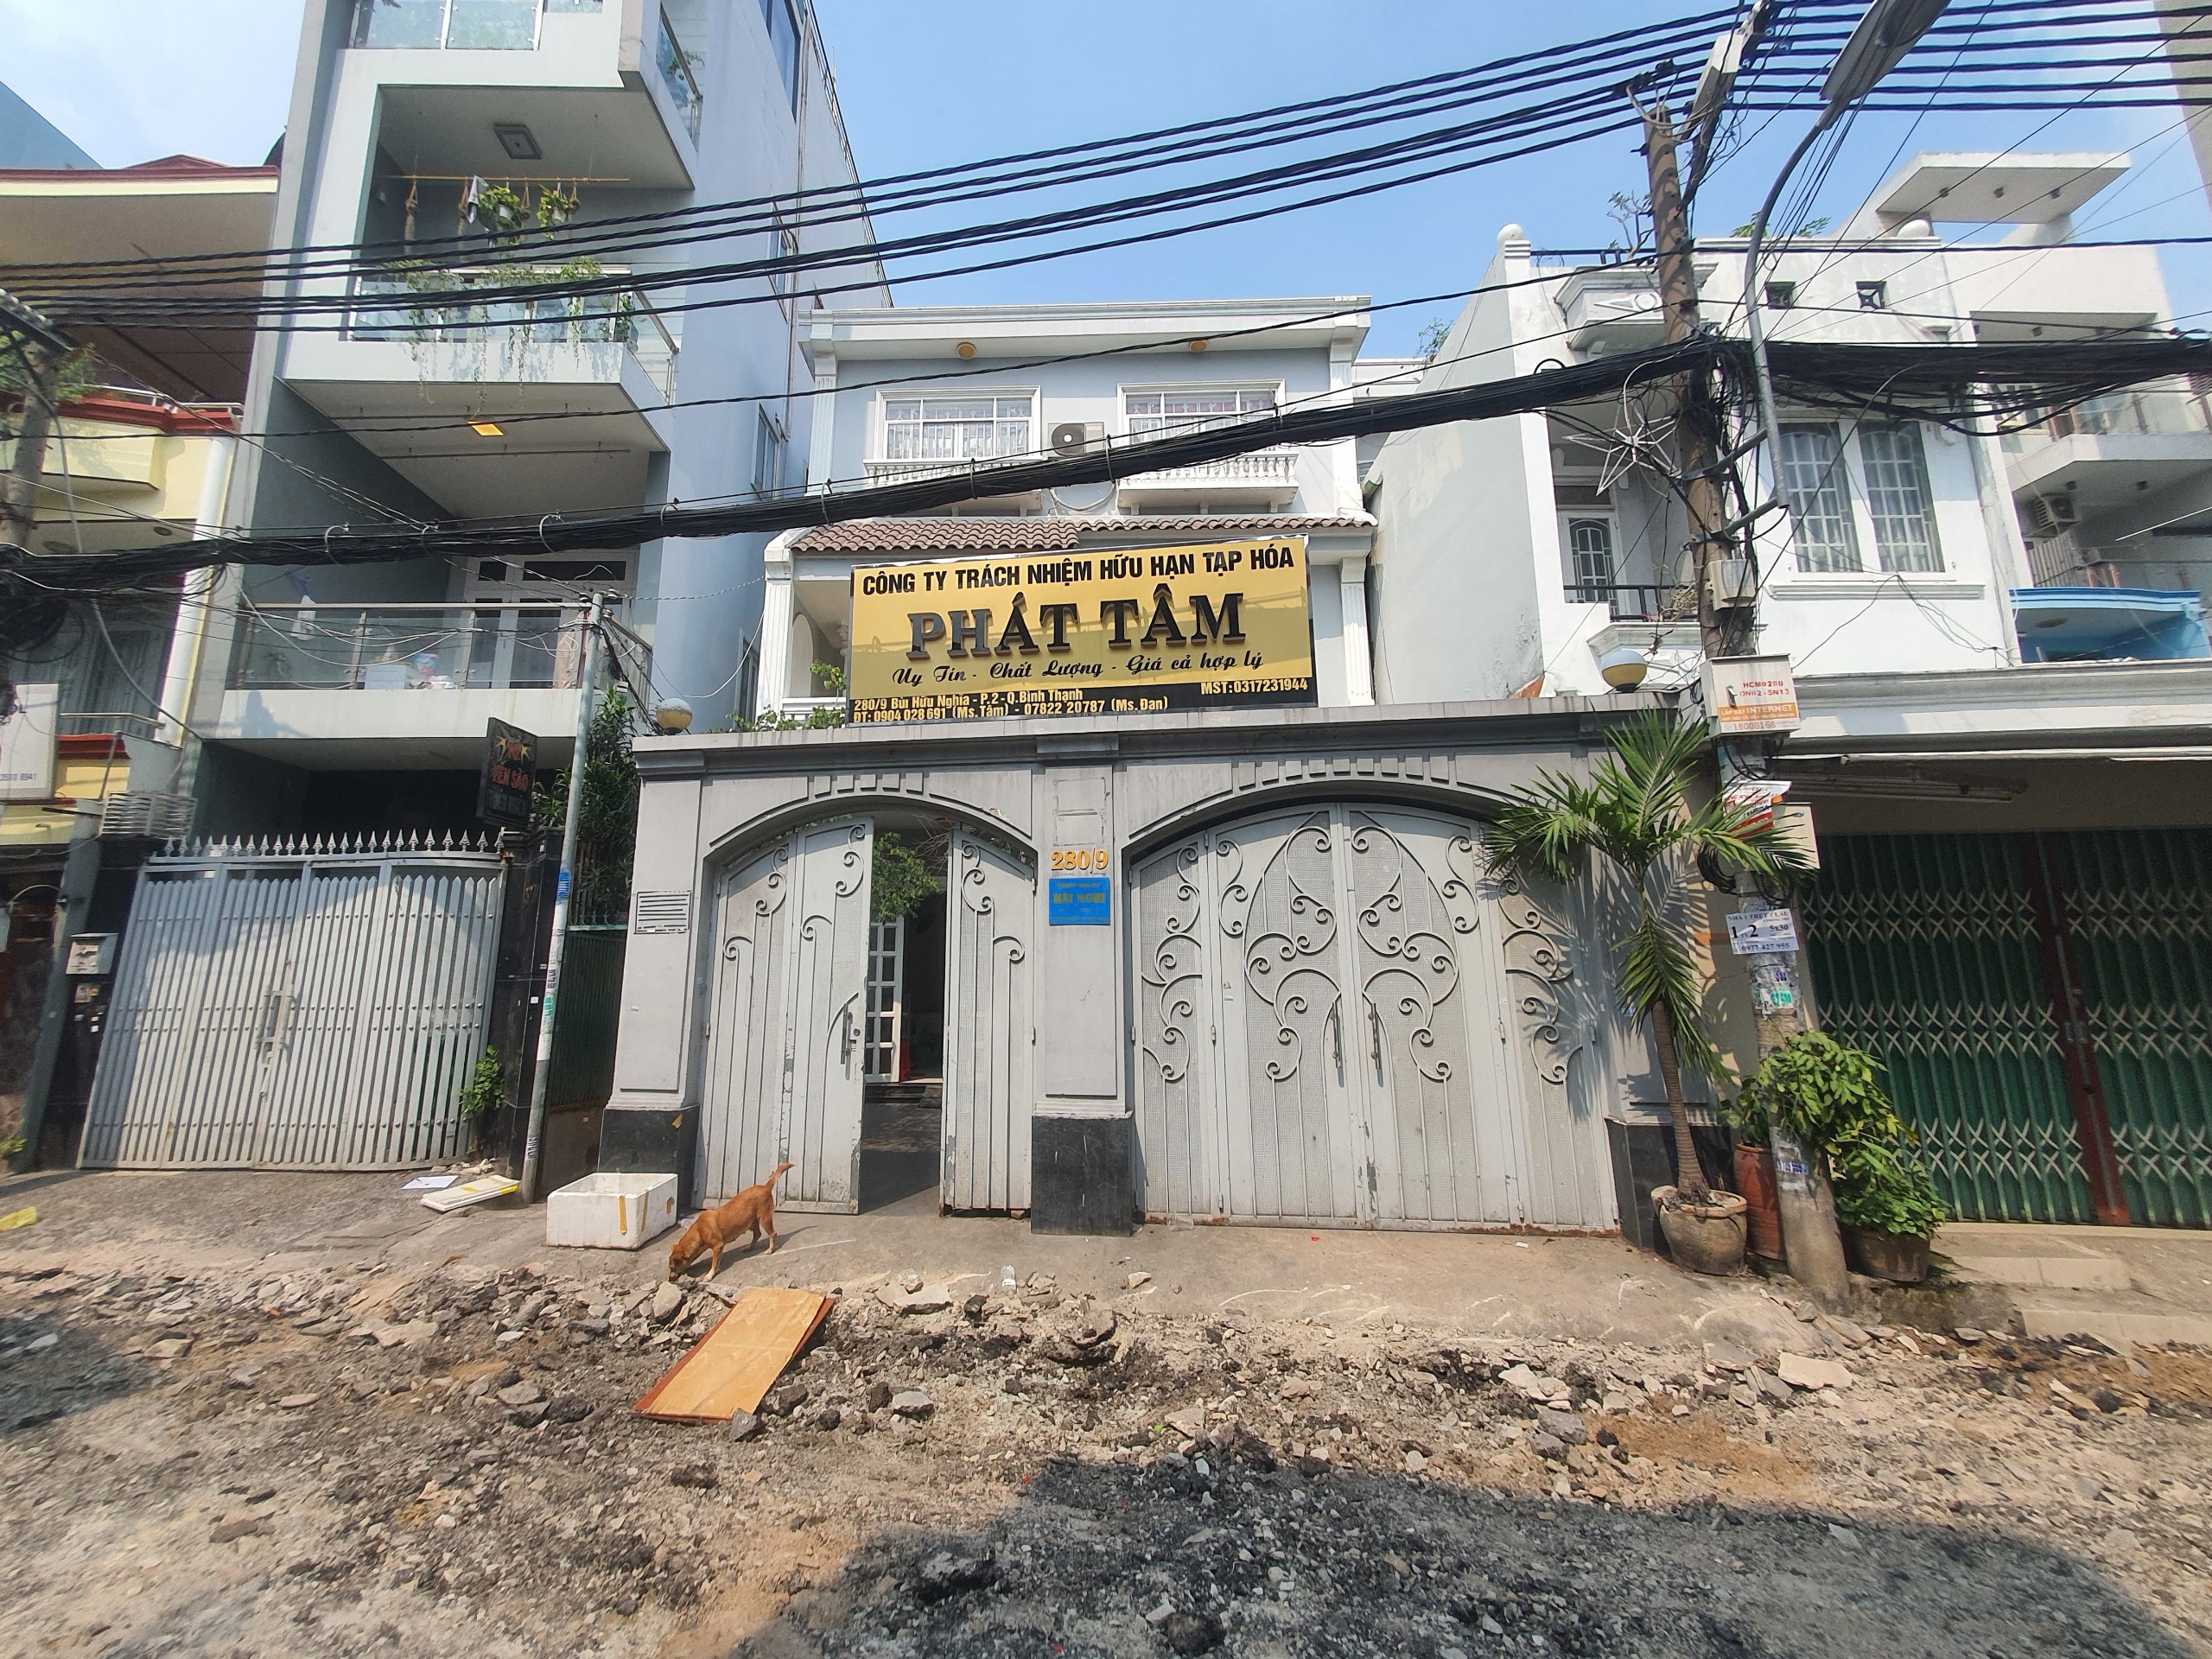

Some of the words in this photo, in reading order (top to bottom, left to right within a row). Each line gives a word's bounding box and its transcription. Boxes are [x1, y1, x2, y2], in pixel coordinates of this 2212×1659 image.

[862, 571, 916, 595] CÔNG
[923, 570, 948, 592] TY
[955, 563, 1020, 590] TRÁCH
[1027, 558, 1092, 587] NHIỆM
[1100, 553, 1142, 580] HỮU
[1150, 553, 1195, 580] HẠN
[1202, 550, 1243, 577] TẠP
[1249, 543, 1294, 570] HÓA
[906, 591, 1080, 661] PHÁT
[1099, 583, 1247, 649] TÂM
[892, 668, 924, 687] Uy
[933, 665, 967, 683] Tín
[989, 660, 1033, 678] Chất
[1042, 659, 1104, 679] Lượng
[1125, 654, 1164, 675] Giá
[1171, 655, 1192, 670] cả
[1199, 652, 1238, 671] hợp
[1243, 650, 1264, 670] lý
[854, 699, 887, 711] 280/9
[891, 696, 909, 709] Bùi
[1048, 689, 1083, 703] Thạnh
[874, 709, 901, 722] 0904
[903, 709, 925, 721] 028
[926, 707, 946, 720] 691
[1024, 702, 1063, 715] 07822
[1066, 700, 1105, 714] 20787
[1746, 704, 1793, 714] INTERNET
[1051, 847, 1109, 874] 280/9
[1747, 924, 1759, 938] 2
